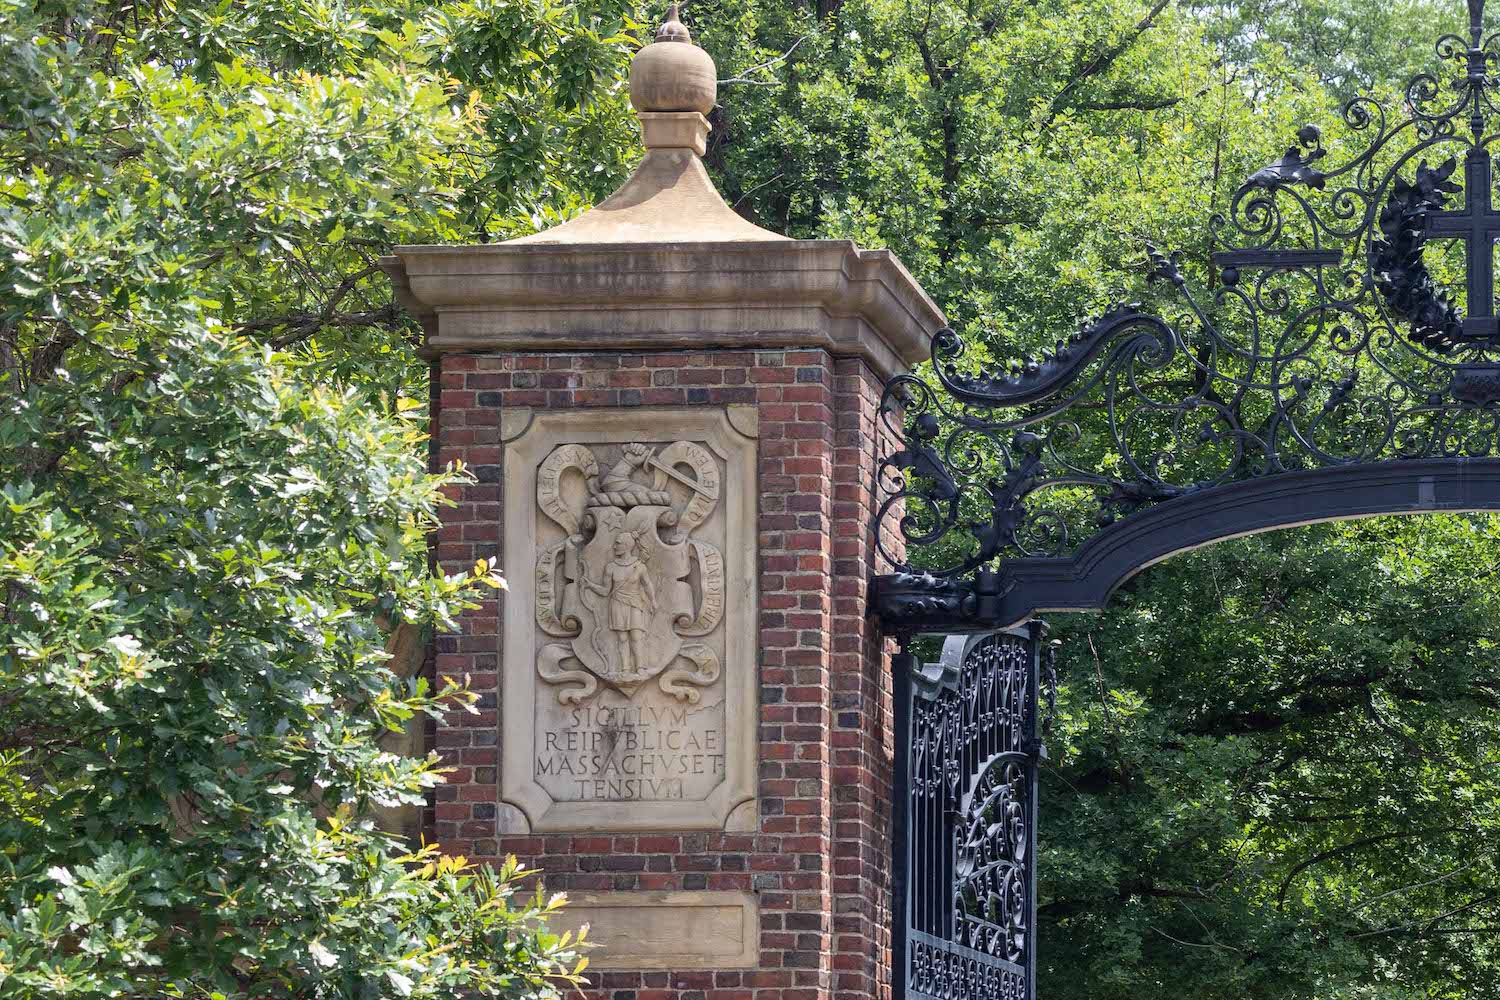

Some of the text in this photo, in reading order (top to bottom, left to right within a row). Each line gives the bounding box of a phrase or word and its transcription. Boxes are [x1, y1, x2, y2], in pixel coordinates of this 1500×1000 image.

[571, 707, 687, 728] SIGILLVM
[545, 730, 717, 751] REIPVBLICAE
[575, 778, 684, 799] TENSIVM
